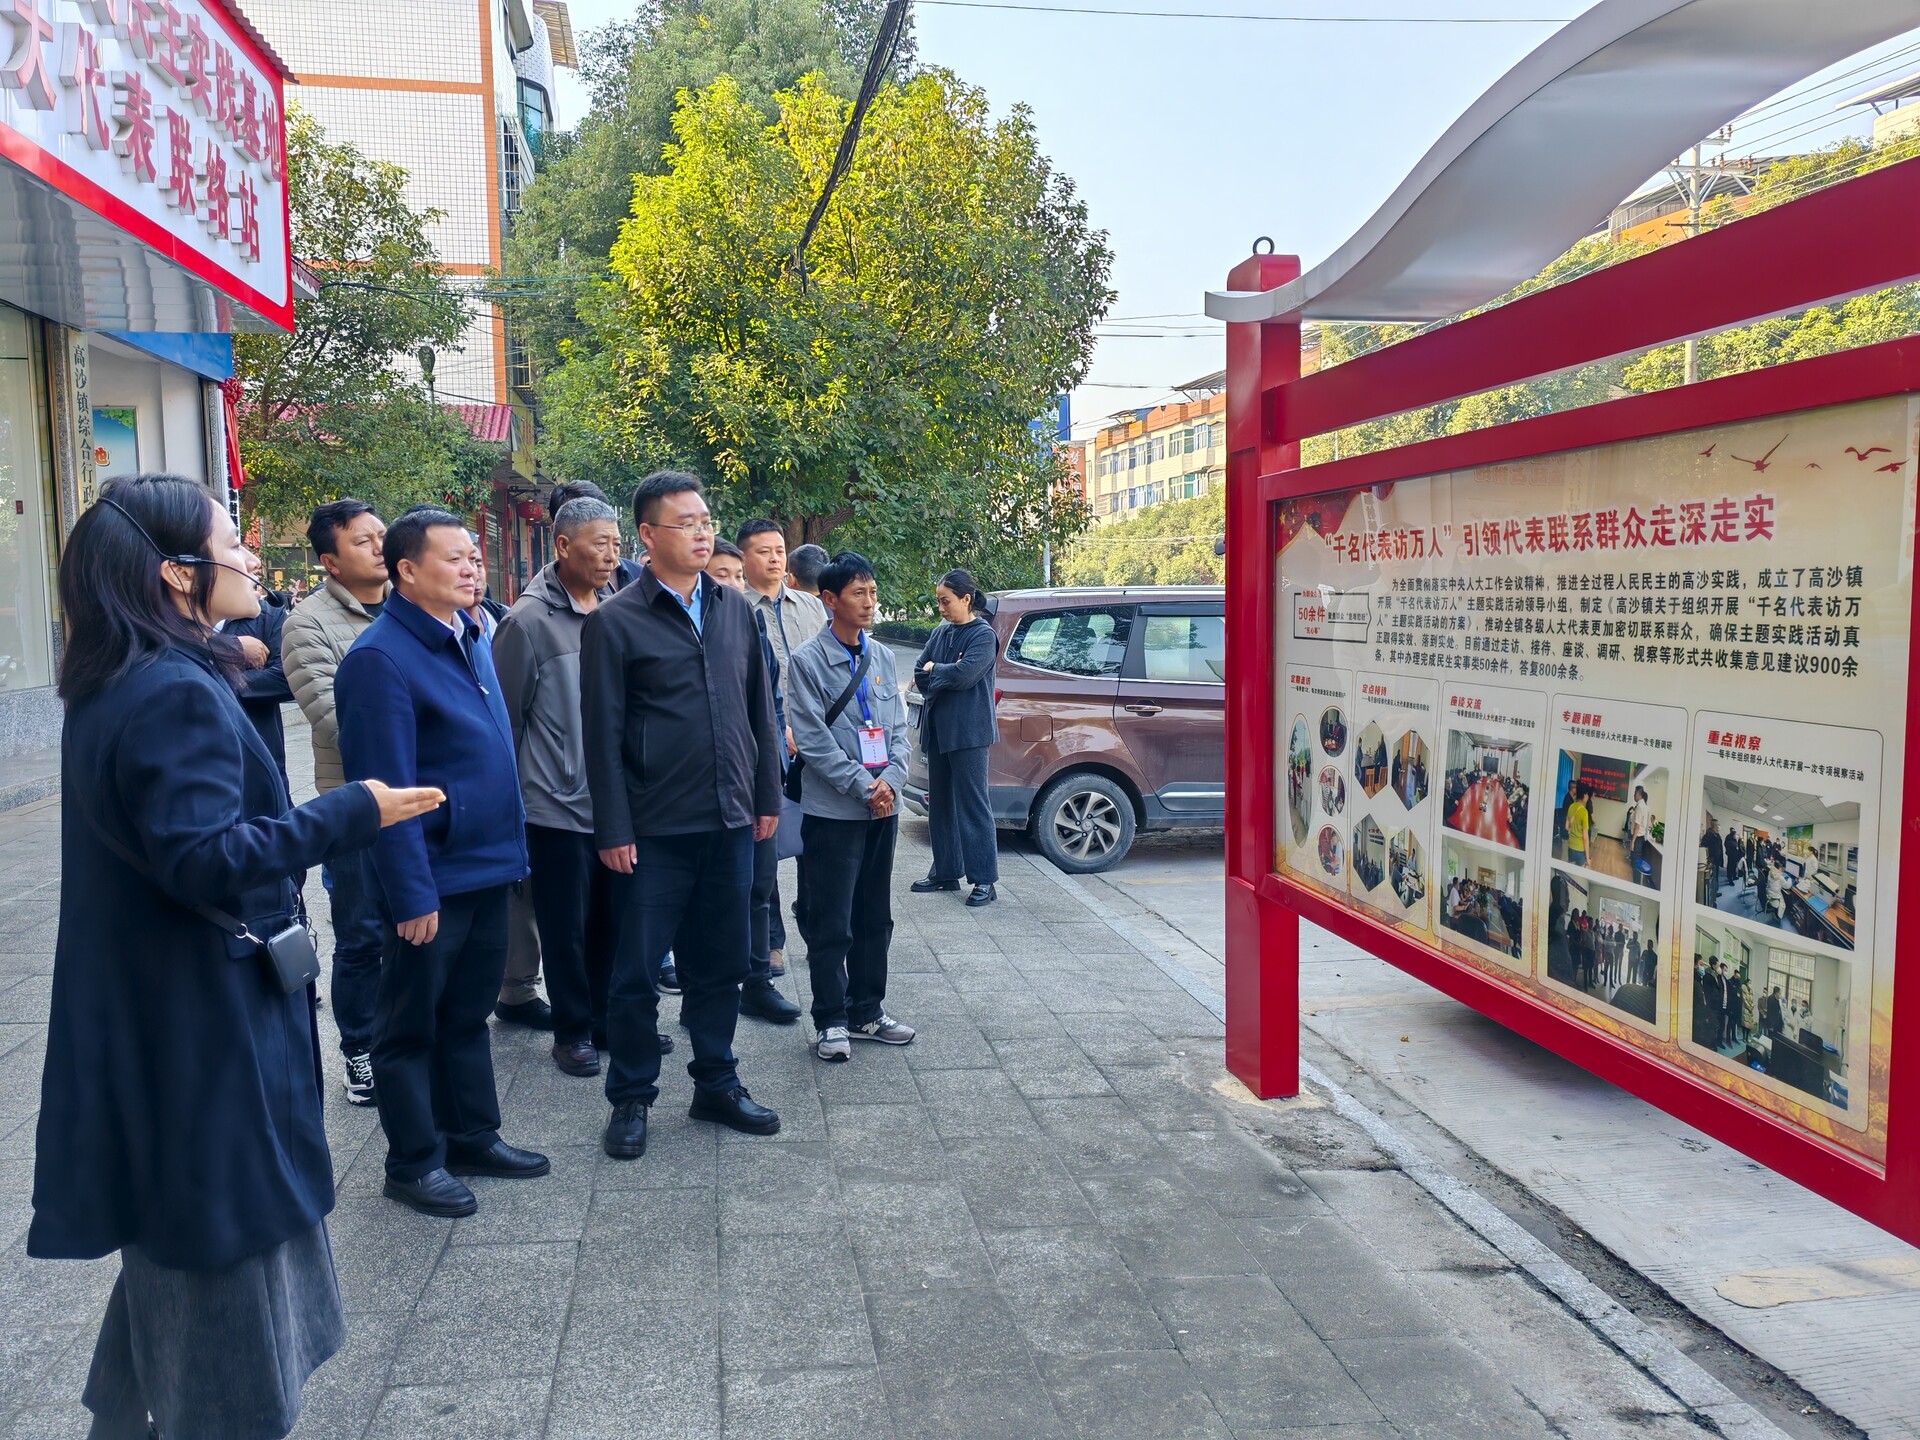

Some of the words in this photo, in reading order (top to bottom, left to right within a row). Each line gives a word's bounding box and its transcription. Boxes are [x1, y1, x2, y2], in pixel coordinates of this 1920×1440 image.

[73, 344, 95, 511] 高沙镇综合行政
[1392, 565, 1863, 592] 为全面贯彻落实中央人大工作会议精神，推进全过程人民民主的高沙实践，成立了高沙镇
[1298, 606, 1325, 622] 50余件
[1375, 649, 1584, 681] 条，其中办理完成民生实事类50余件，答复800余条。
[1450, 695, 1482, 710] 座谈交流
[1562, 710, 1602, 727] 专题调研
[1707, 730, 1761, 751] 重点视察
